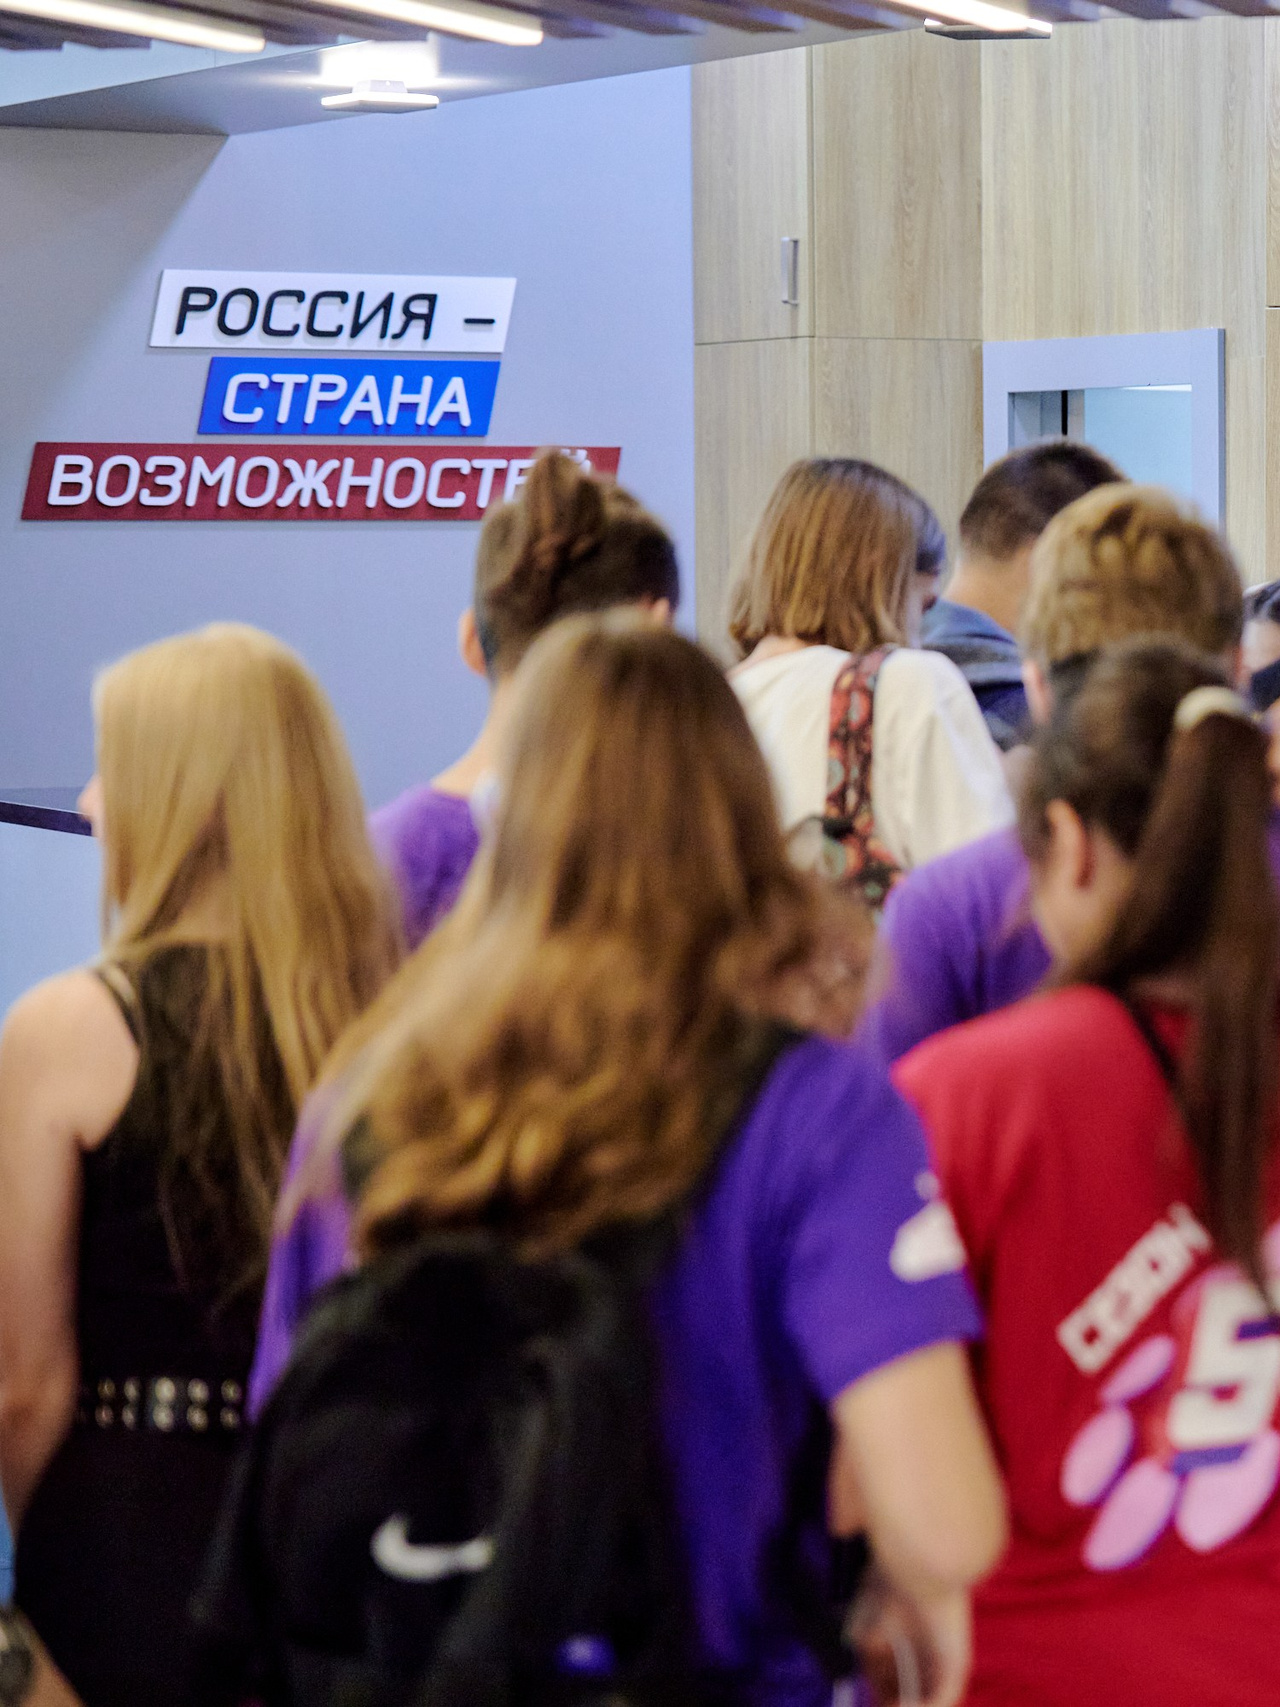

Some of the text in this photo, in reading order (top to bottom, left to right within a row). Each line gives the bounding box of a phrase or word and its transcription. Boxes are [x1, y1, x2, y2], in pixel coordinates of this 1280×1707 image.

[175, 286, 438, 340] РОССИЯ
[221, 373, 472, 427] СТРАНА
[47, 449, 591, 509] ВОЗМОЖНОСТЕ
